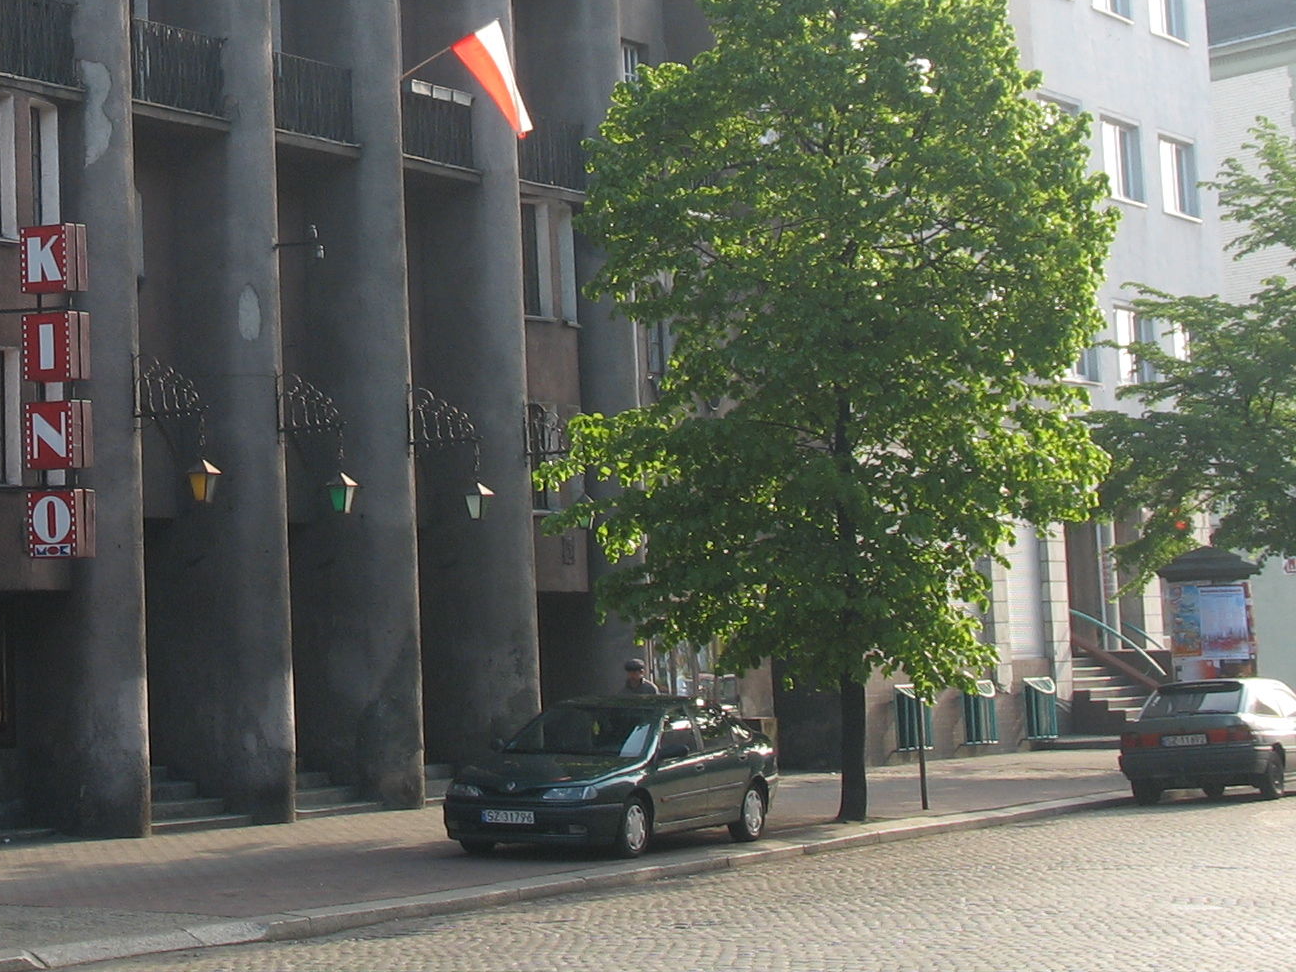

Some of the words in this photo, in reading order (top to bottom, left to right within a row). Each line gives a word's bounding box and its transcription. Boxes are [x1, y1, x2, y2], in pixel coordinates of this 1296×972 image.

[26, 234, 72, 544] KINO
[36, 546, 69, 556] MOK
[487, 810, 500, 822] SZ
